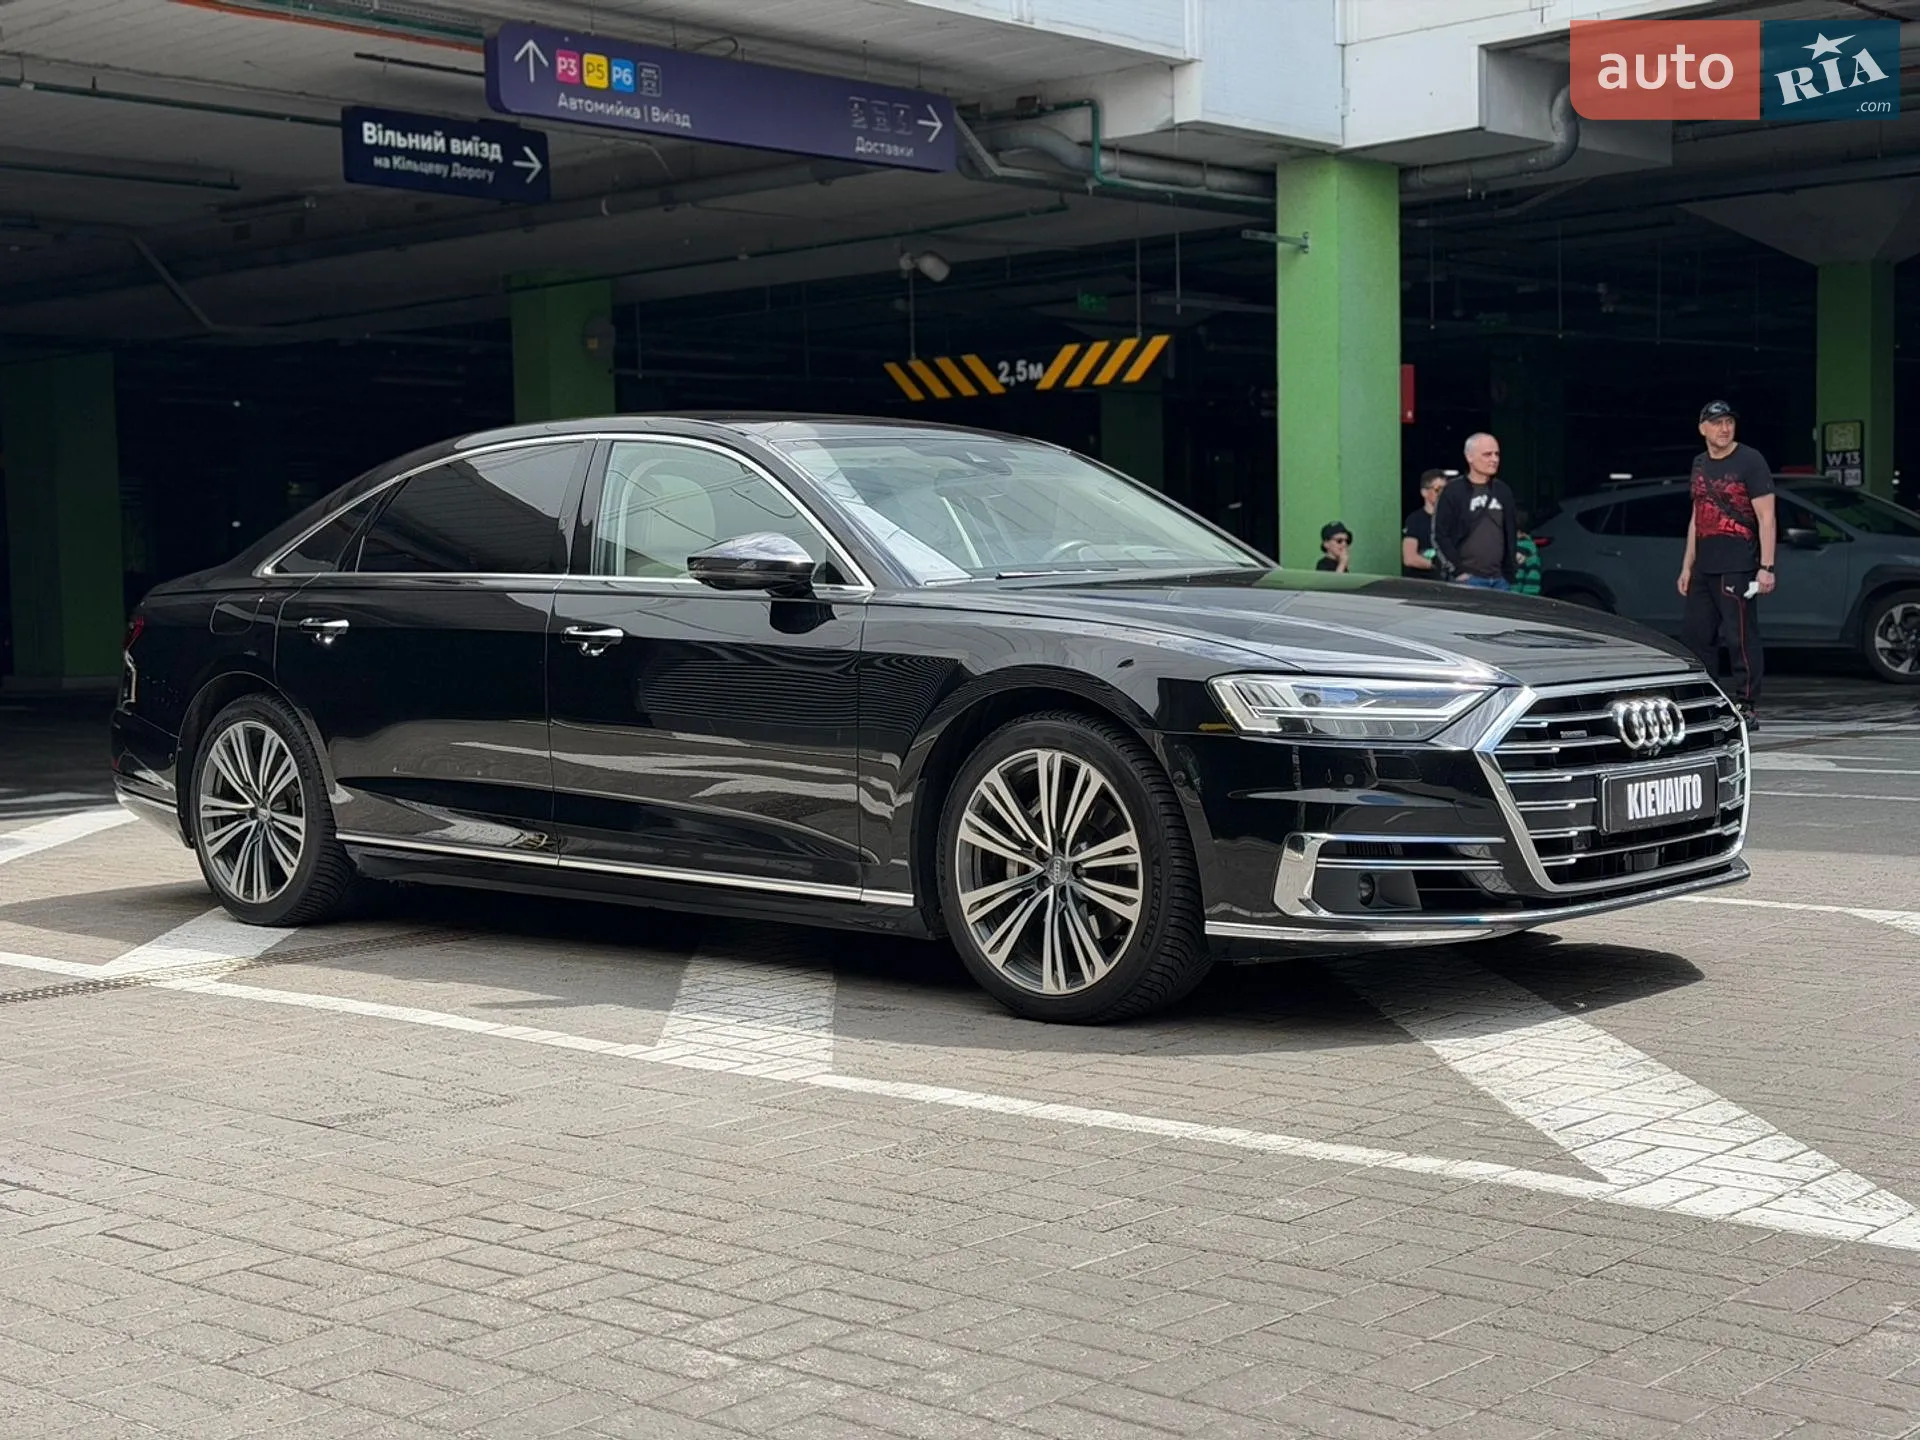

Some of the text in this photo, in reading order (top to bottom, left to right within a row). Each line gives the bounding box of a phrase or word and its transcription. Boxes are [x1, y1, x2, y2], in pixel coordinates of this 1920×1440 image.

[557, 57, 633, 86] P3 P5 P6
[558, 92, 641, 120] Автомийка
[652, 106, 692, 129] Виїзд
[362, 121, 503, 163] Вільний виїзд
[854, 135, 915, 157] Доставки
[373, 155, 496, 184] на Кільцеву Дорогу
[1627, 773, 1702, 821] KIEVAVTO
